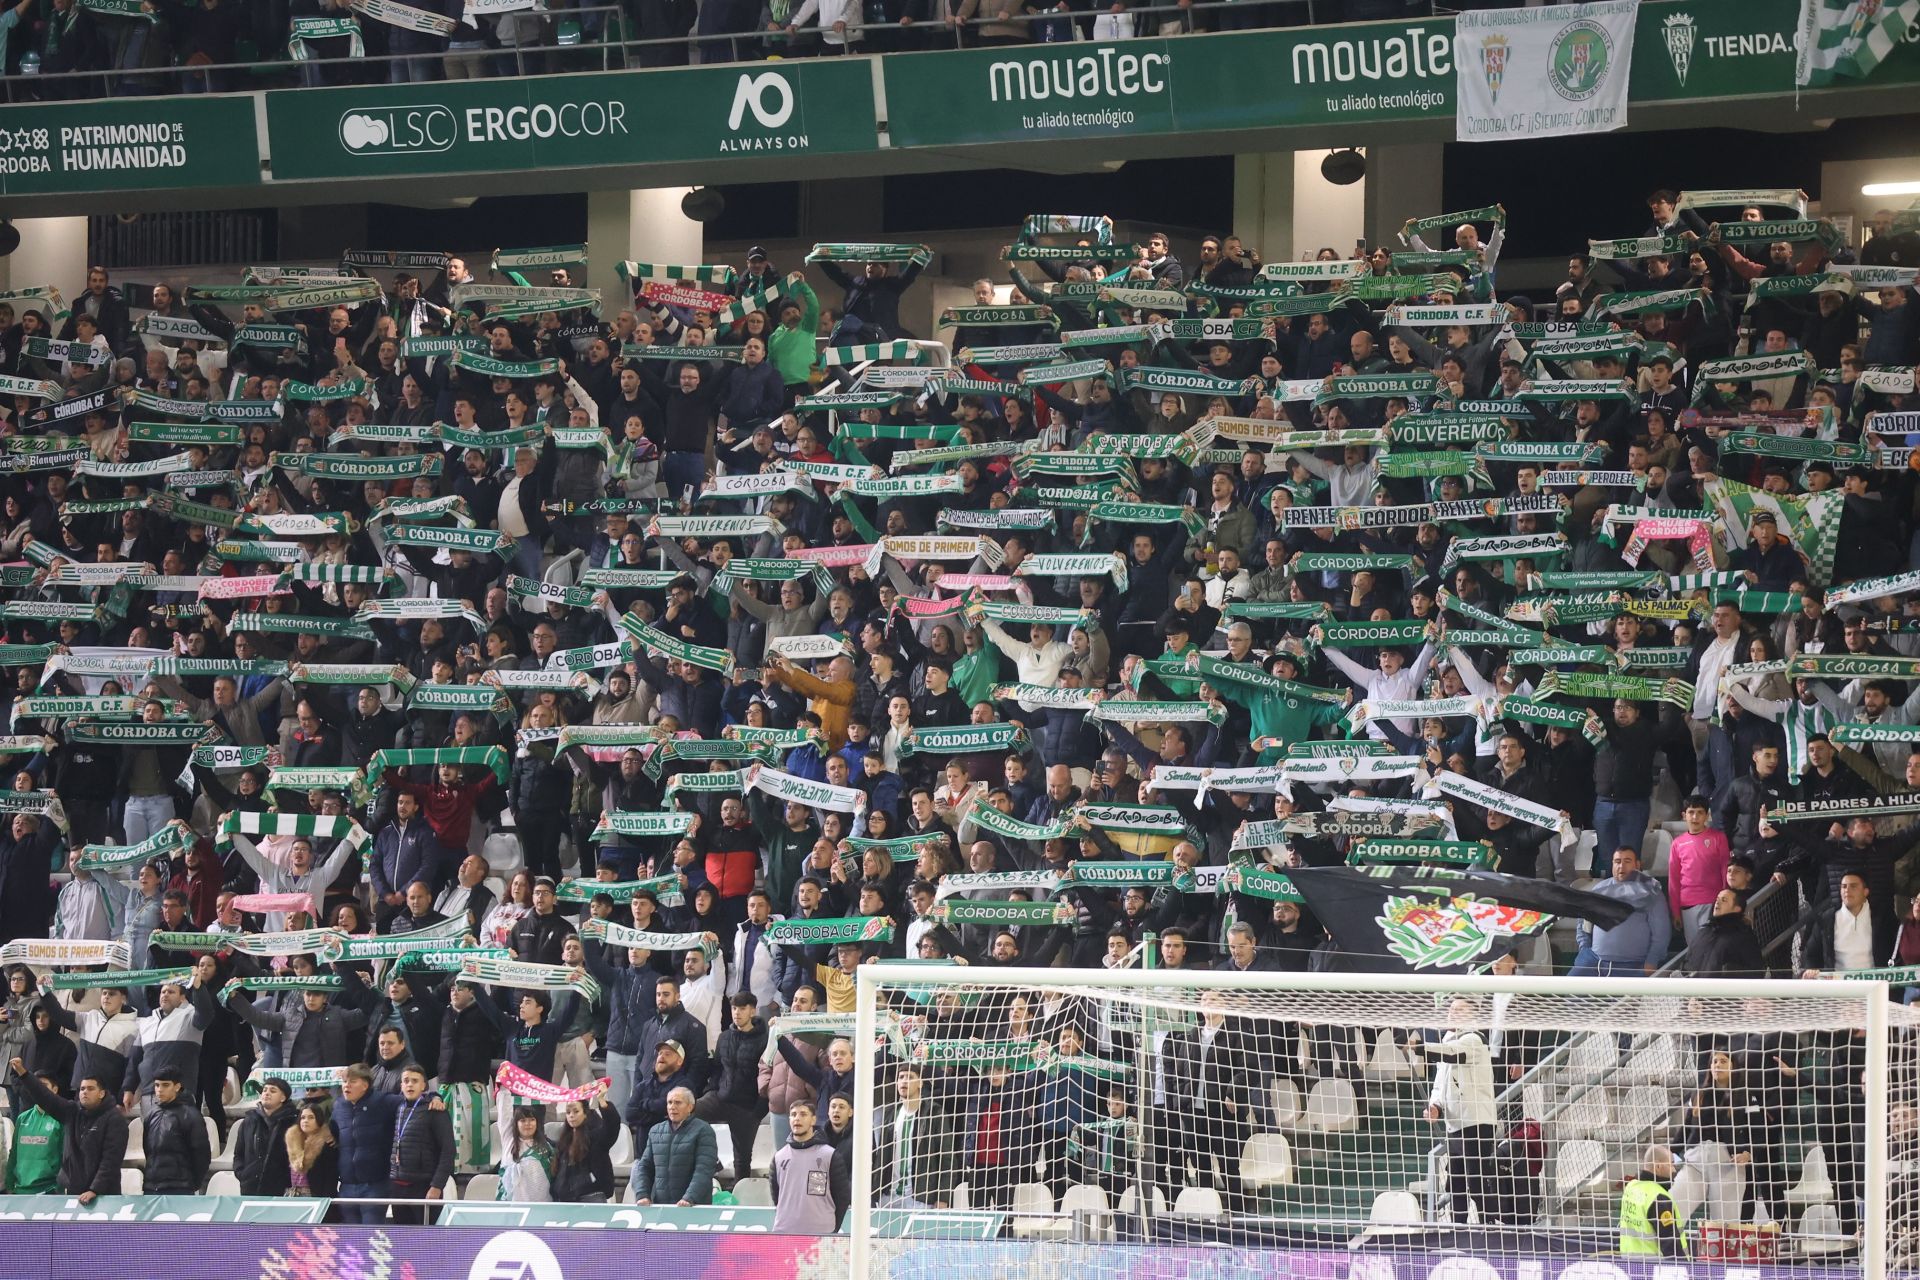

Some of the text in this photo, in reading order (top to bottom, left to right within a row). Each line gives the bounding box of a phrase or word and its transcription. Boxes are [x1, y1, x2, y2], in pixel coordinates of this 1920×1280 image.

[1704, 32, 1798, 59] TIENDA.
[1326, 89, 1444, 112] tu aliado tecnológico
[467, 101, 629, 142] ERGOCOR
[1022, 109, 1134, 129] tu aliado tecnológico
[61, 123, 183, 147] PATRIMONIO DE
[390, 110, 448, 148] LSC
[173, 133, 184, 142] LA
[719, 135, 809, 152] ALWAYS ON
[62, 144, 186, 171] HUMANIDAD
[516, 254, 564, 265] CÓRDOBA
[1850, 270, 1899, 282] VOLVEREMOS
[659, 293, 713, 309] CORDOBESA
[672, 287, 704, 300] MUJER
[1122, 292, 1183, 306] CÓRDOBA
[966, 310, 1026, 321] CÓRDOBA
[1464, 308, 1484, 319] C.F.
[1161, 320, 1256, 336] CÓRDOBA CF
[17, 378, 34, 391] C.F.
[1147, 372, 1236, 390] CÓRDOBA CF
[1338, 376, 1432, 394] CÓRDOBA CF
[54, 394, 105, 419] CÓRDOBA CF
[209, 405, 272, 418] CÓRDOBA
[1217, 420, 1265, 435] SOMOS DE
[1416, 416, 1448, 427] Córdoba
[1449, 417, 1465, 426] Club
[456, 431, 510, 445] CÓRDOBA
[1391, 420, 1507, 443] VOLVEREMOS
[1500, 441, 1580, 456] CÓRDOBA CF
[95, 459, 158, 473] VOLVEREMOS
[330, 461, 416, 475] CÓRDOBA CF
[1101, 456, 1117, 466] CF
[726, 474, 786, 490] CÓRDOBA
[914, 478, 933, 491] C.F.
[1542, 471, 1576, 483] FRENTE
[581, 500, 643, 510] CÓRDOBA
[1099, 503, 1166, 518] CÓRDOBA
[1433, 495, 1559, 517] FRENTE PEROLE
[1284, 506, 1432, 525] FRENTE CÓRDOB
[268, 517, 317, 530] CÓRDOBA
[680, 518, 756, 532] VOLVEREMOS
[408, 526, 492, 547] CÓRDOBA CF
[883, 539, 975, 553] SOMOS DE PRIMERA
[1038, 556, 1106, 572] VOLVEREMOS
[1308, 555, 1393, 570] CÓRDOBA CF
[1631, 600, 1689, 611] LAS PALMAS
[1328, 626, 1421, 640] CÓRDOBA CF
[776, 639, 835, 654] CÓRDOBA
[1514, 649, 1596, 663] CÓRDOBA CF
[1825, 660, 1900, 674] CÓRDOBA
[508, 671, 563, 684] CÓRDOBA
[416, 690, 496, 705] CÓRDOBA CF
[101, 700, 124, 711] C.F.
[1503, 700, 1586, 724] CÓRDOBA CF
[102, 723, 203, 739] CÓRDOBA CF
[745, 729, 799, 743] CÓRDOBA
[923, 729, 1011, 746] CÓRDOBA CF
[1286, 760, 1419, 773] ntimiento Blanquive
[1786, 800, 1804, 813] DE
[1810, 798, 1870, 811] PADRES
[1873, 797, 1884, 807] A
[101, 832, 174, 863] CÓRDOBA CF
[1356, 841, 1480, 860] CÓRDOBA C. F.
[1078, 864, 1166, 881] CÓRDOBA CF
[954, 906, 1050, 919] CÓRDOBA CF
[773, 923, 859, 940] CÓRDOBA CF
[28, 943, 104, 958] SOMOS DE PRIMERA
[349, 938, 383, 956] SUEÑOS
[528, 1078, 561, 1095] MUJER
